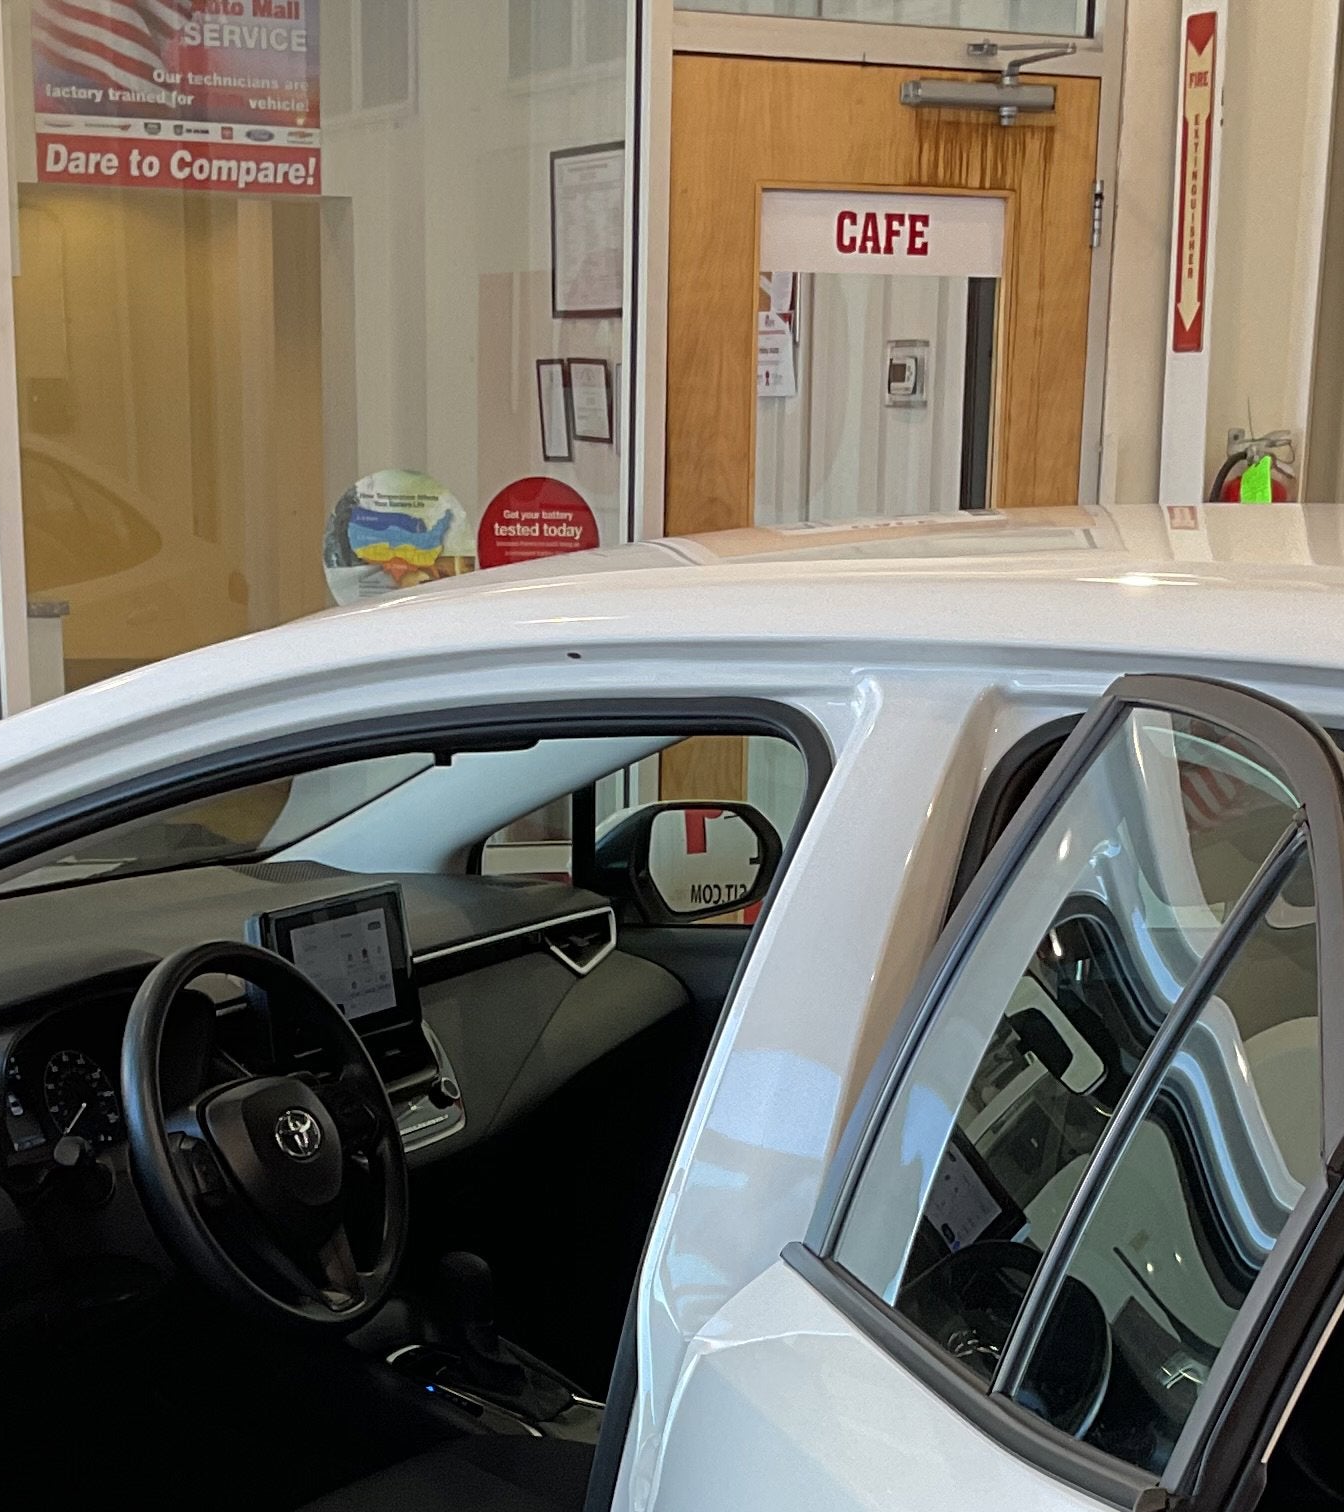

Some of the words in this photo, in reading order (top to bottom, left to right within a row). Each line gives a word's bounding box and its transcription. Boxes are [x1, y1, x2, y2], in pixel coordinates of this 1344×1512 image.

[251, 0, 300, 20] Mall
[184, 22, 307, 52] SERVICE
[153, 69, 182, 84] Our
[188, 72, 279, 90] technicians
[284, 79, 309, 91] are
[1188, 71, 1209, 88] FIRE
[45, 84, 103, 102] factory
[108, 87, 163, 103] trained
[164, 90, 195, 109] for
[45, 143, 120, 176] Dare
[129, 149, 161, 177] to
[169, 150, 317, 188] Compare!
[1187, 113, 1201, 279] EXTINGUISHER
[836, 210, 929, 256] CAFE
[503, 510, 520, 519] Get
[521, 511, 540, 521] your
[542, 510, 573, 521] battery
[494, 522, 539, 537] tested
[543, 523, 583, 540] today
